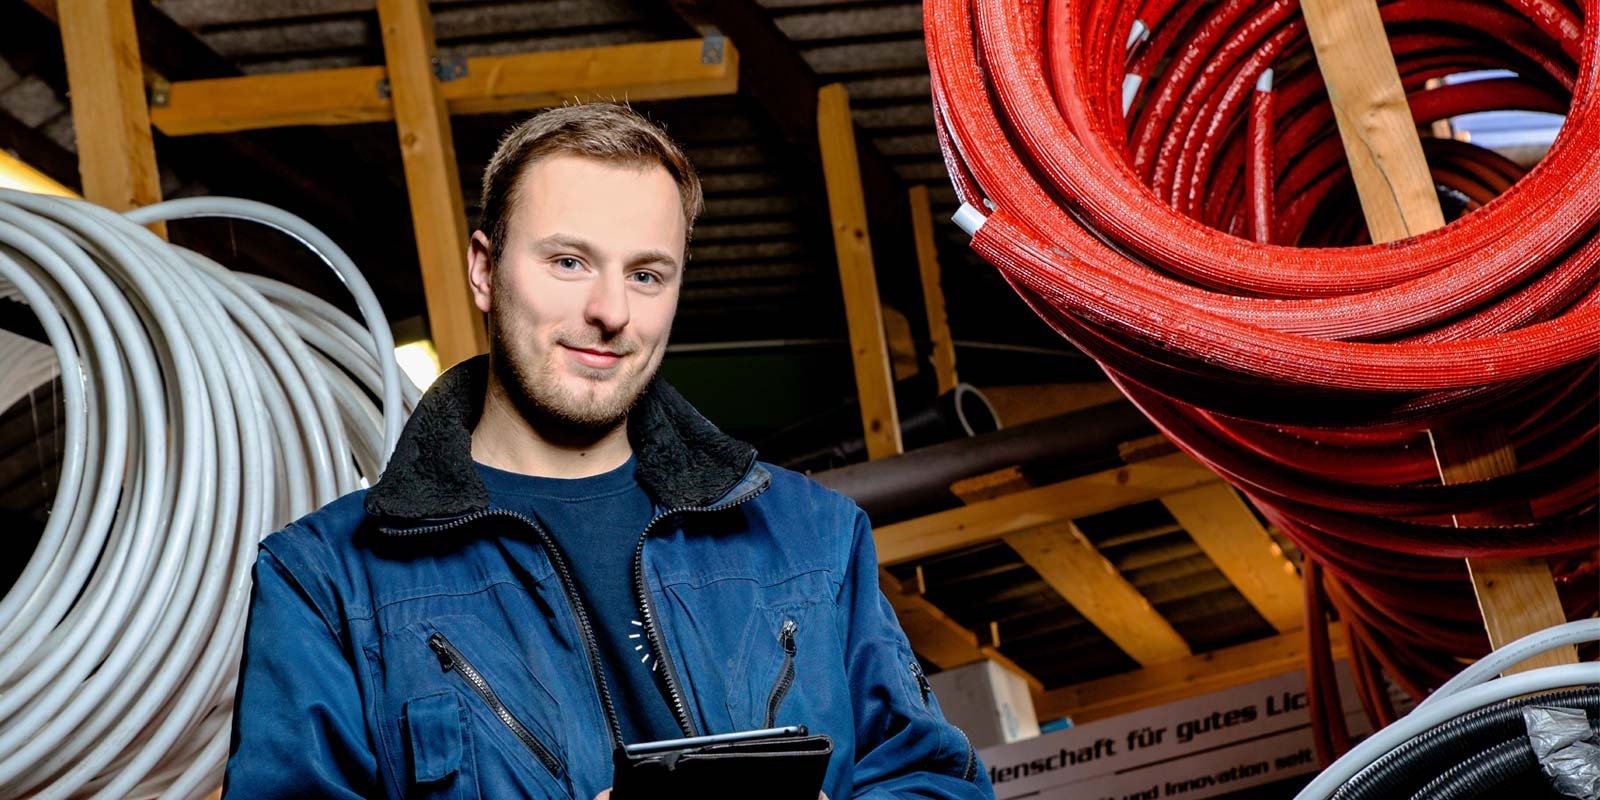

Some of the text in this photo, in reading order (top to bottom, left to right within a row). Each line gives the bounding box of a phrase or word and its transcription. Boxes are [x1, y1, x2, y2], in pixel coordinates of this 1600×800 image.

[1127, 728, 1167, 751] für
[1177, 706, 1257, 743] gutes
[1165, 761, 1269, 796] Innovation
[1274, 749, 1313, 772] seit
